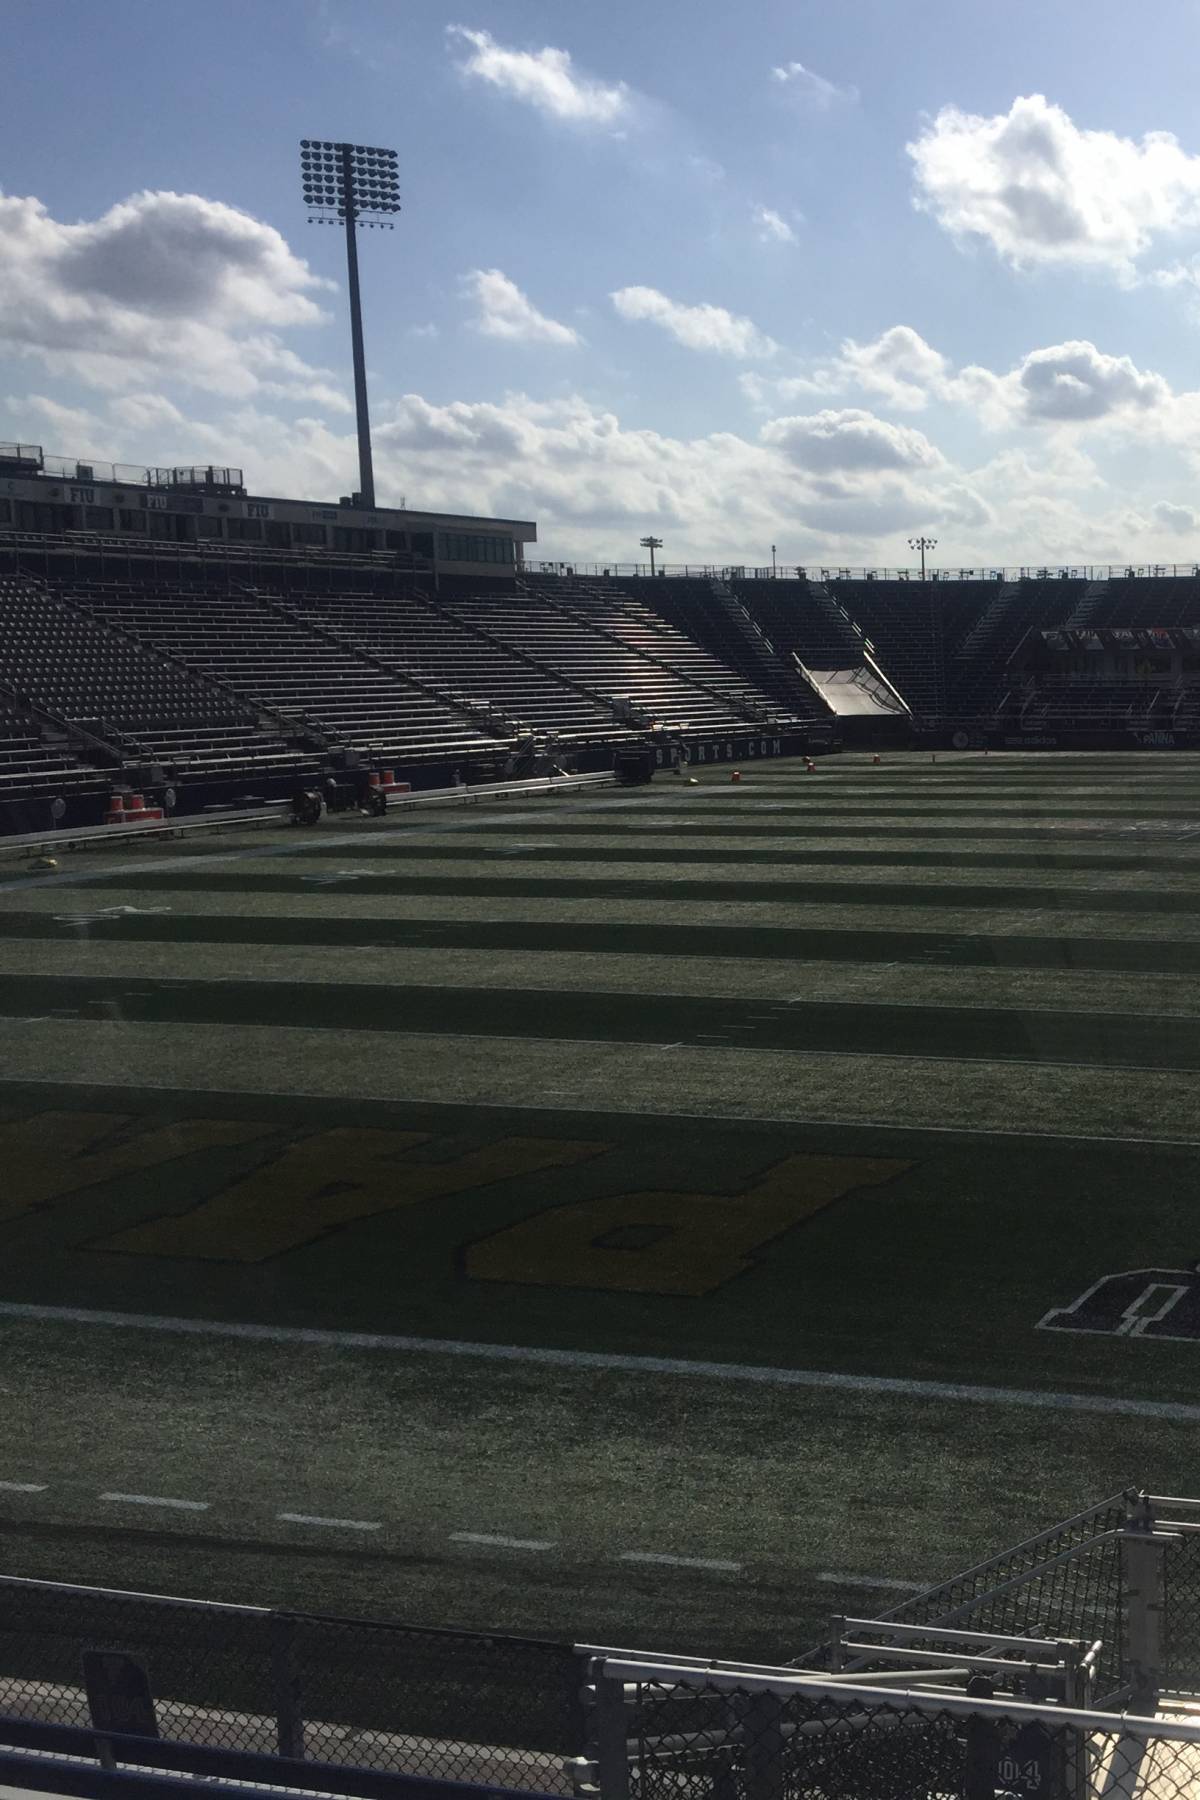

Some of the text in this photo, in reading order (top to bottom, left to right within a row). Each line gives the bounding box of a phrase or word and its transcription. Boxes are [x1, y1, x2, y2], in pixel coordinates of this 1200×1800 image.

[70, 486, 95, 504] FIU
[146, 494, 168, 509] FIU
[247, 503, 269, 518] FIU
